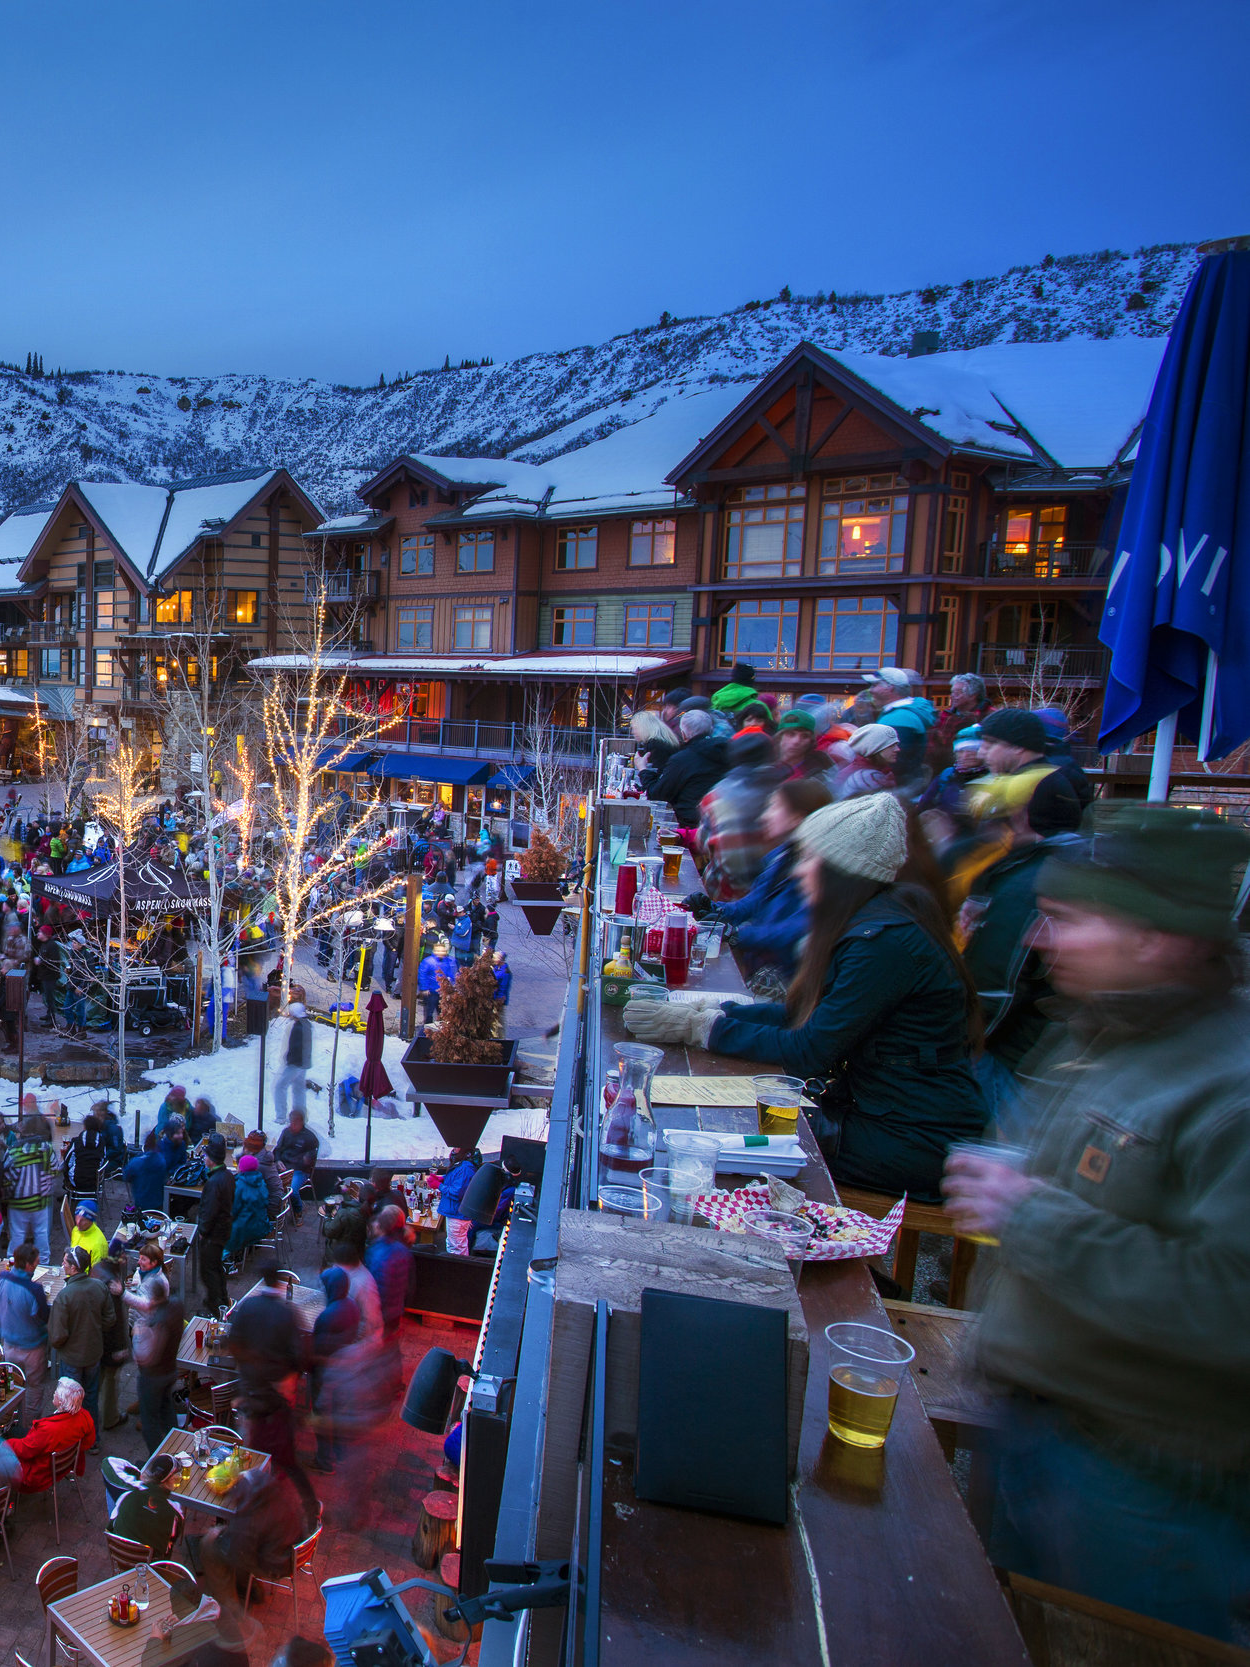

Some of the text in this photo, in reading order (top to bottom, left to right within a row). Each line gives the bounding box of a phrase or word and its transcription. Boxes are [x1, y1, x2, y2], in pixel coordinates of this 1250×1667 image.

[44, 881, 93, 906] ASPEN SNOWMASS
[136, 898, 212, 911] ASPEN SNOWMASS
